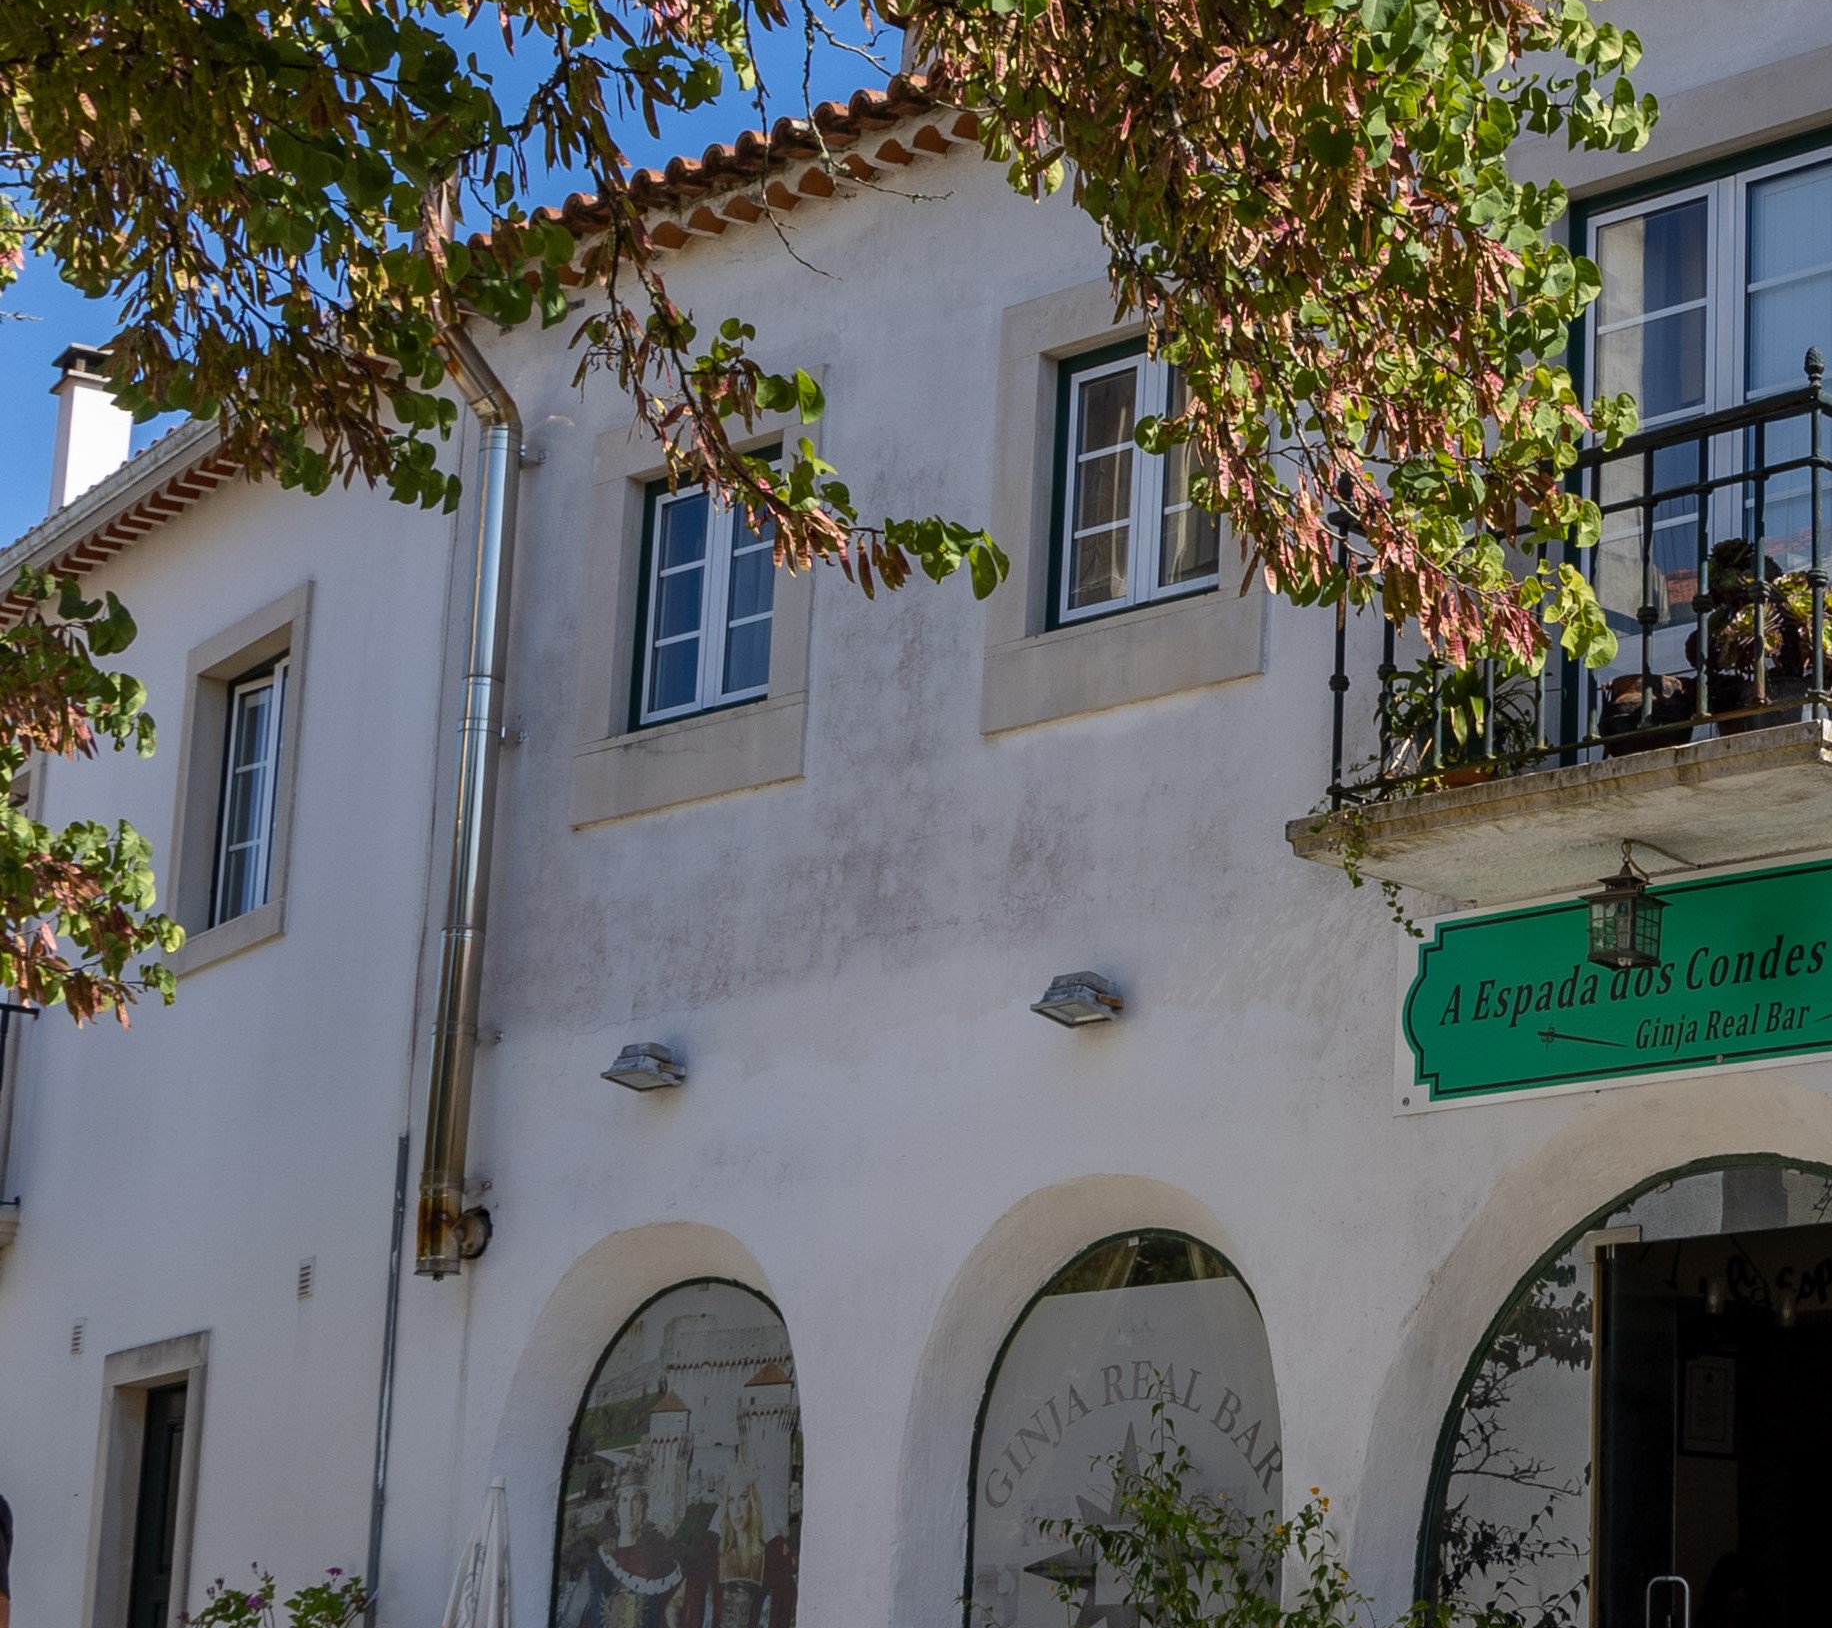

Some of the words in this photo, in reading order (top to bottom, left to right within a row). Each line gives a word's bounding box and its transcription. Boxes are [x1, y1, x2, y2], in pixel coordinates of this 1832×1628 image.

[1438, 984, 1461, 1026] A
[1471, 964, 1600, 1028] Espada
[1610, 961, 1675, 1002] dos
[1685, 934, 1827, 992] Condes
[1635, 1013, 1698, 1054] Ginja
[1704, 1003, 1760, 1041] Real
[1764, 1001, 1811, 1034] Bar
[984, 1383, 1093, 1509] GINJA
[1100, 1360, 1203, 1414] REAL
[1209, 1386, 1283, 1495] BAR
